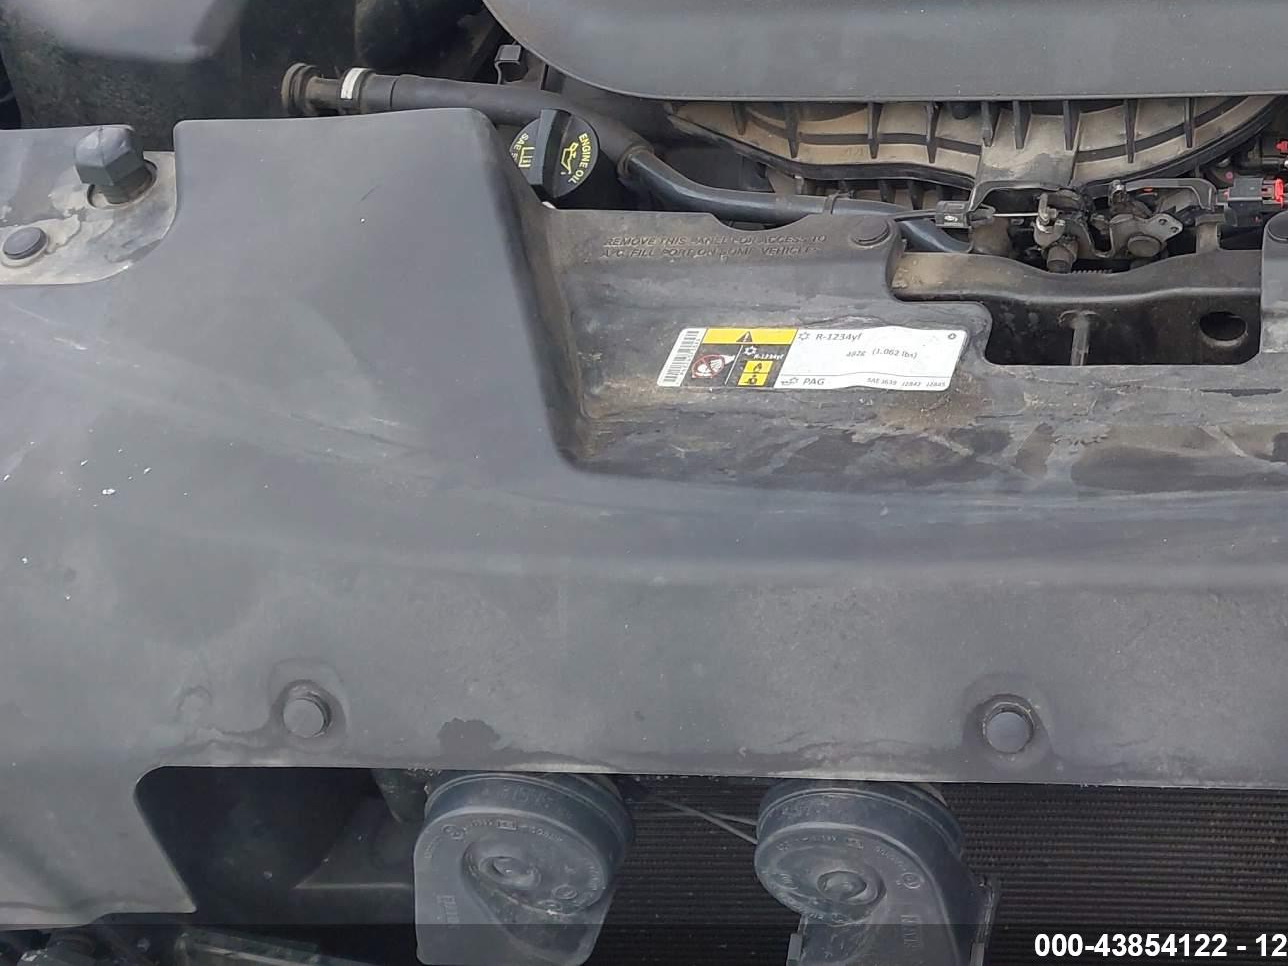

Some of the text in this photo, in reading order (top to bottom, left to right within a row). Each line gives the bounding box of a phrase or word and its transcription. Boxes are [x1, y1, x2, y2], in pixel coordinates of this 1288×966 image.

[513, 133, 529, 151] SAE
[567, 132, 592, 184] ENGINE OIL
[604, 236, 658, 246] REMOVE
[690, 235, 728, 245] ANEL
[630, 248, 657, 258] FILL
[720, 245, 754, 256] OME
[761, 245, 820, 256] VEHICLE
[815, 332, 863, 343] R-1234yf
[803, 377, 825, 386] PAG
